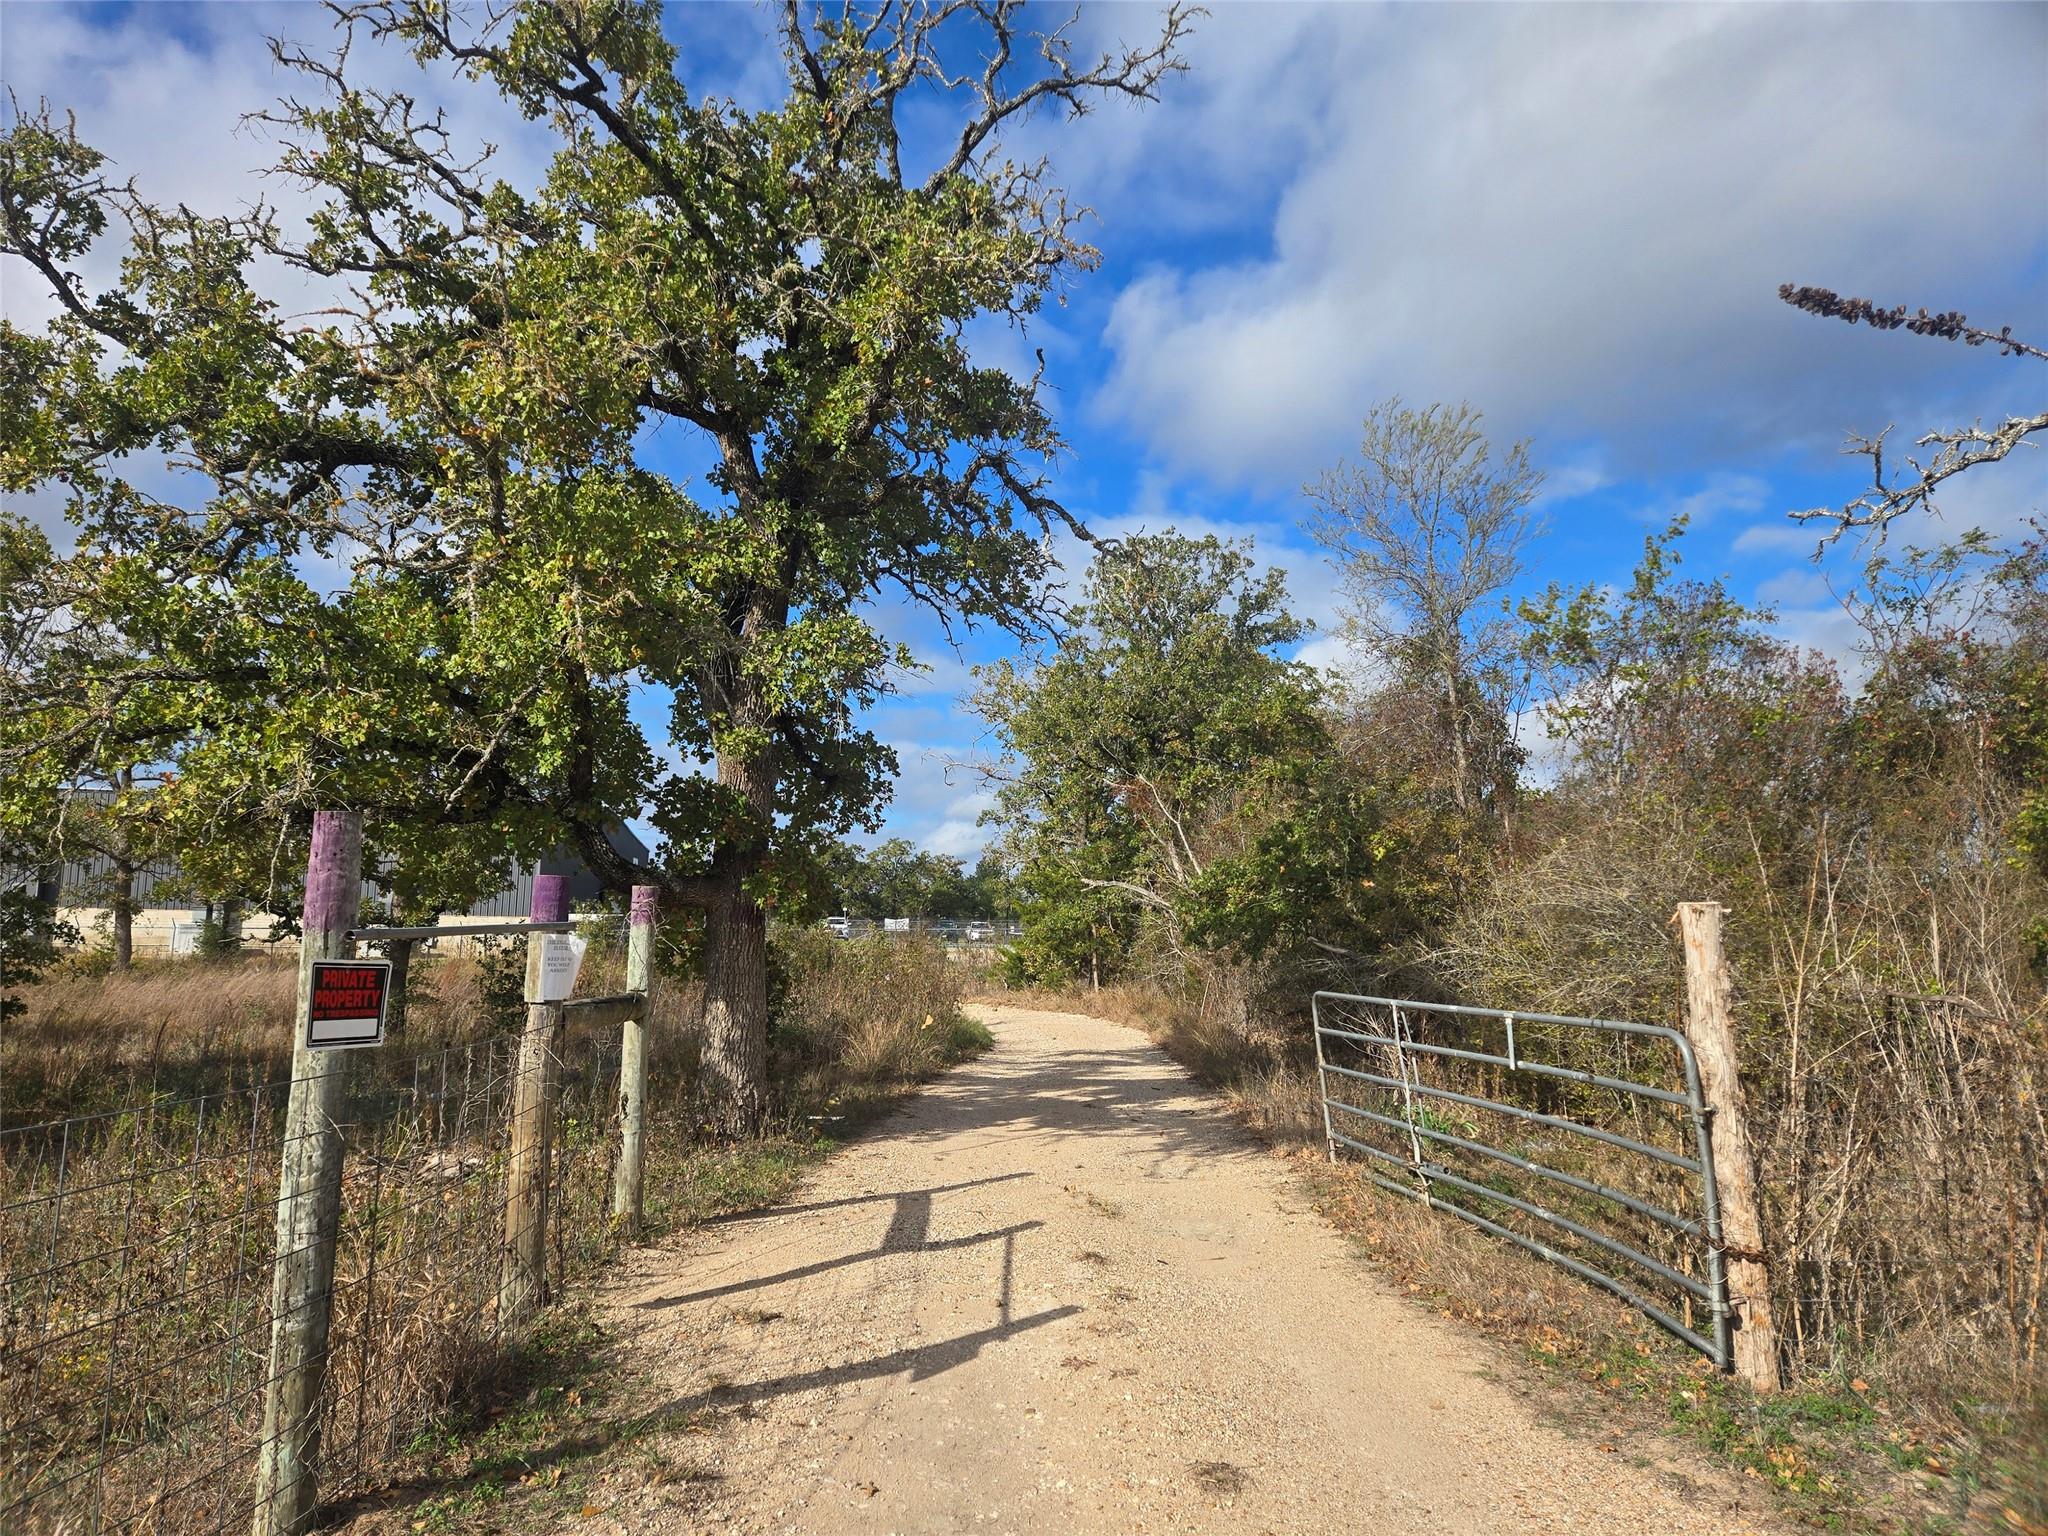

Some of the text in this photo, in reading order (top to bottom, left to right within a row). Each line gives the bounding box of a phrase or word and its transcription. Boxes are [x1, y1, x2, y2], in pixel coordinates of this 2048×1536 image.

[322, 969, 377, 988] PRIVATE
[314, 989, 381, 1008] PROPERTY
[312, 1010, 324, 1018] NO
